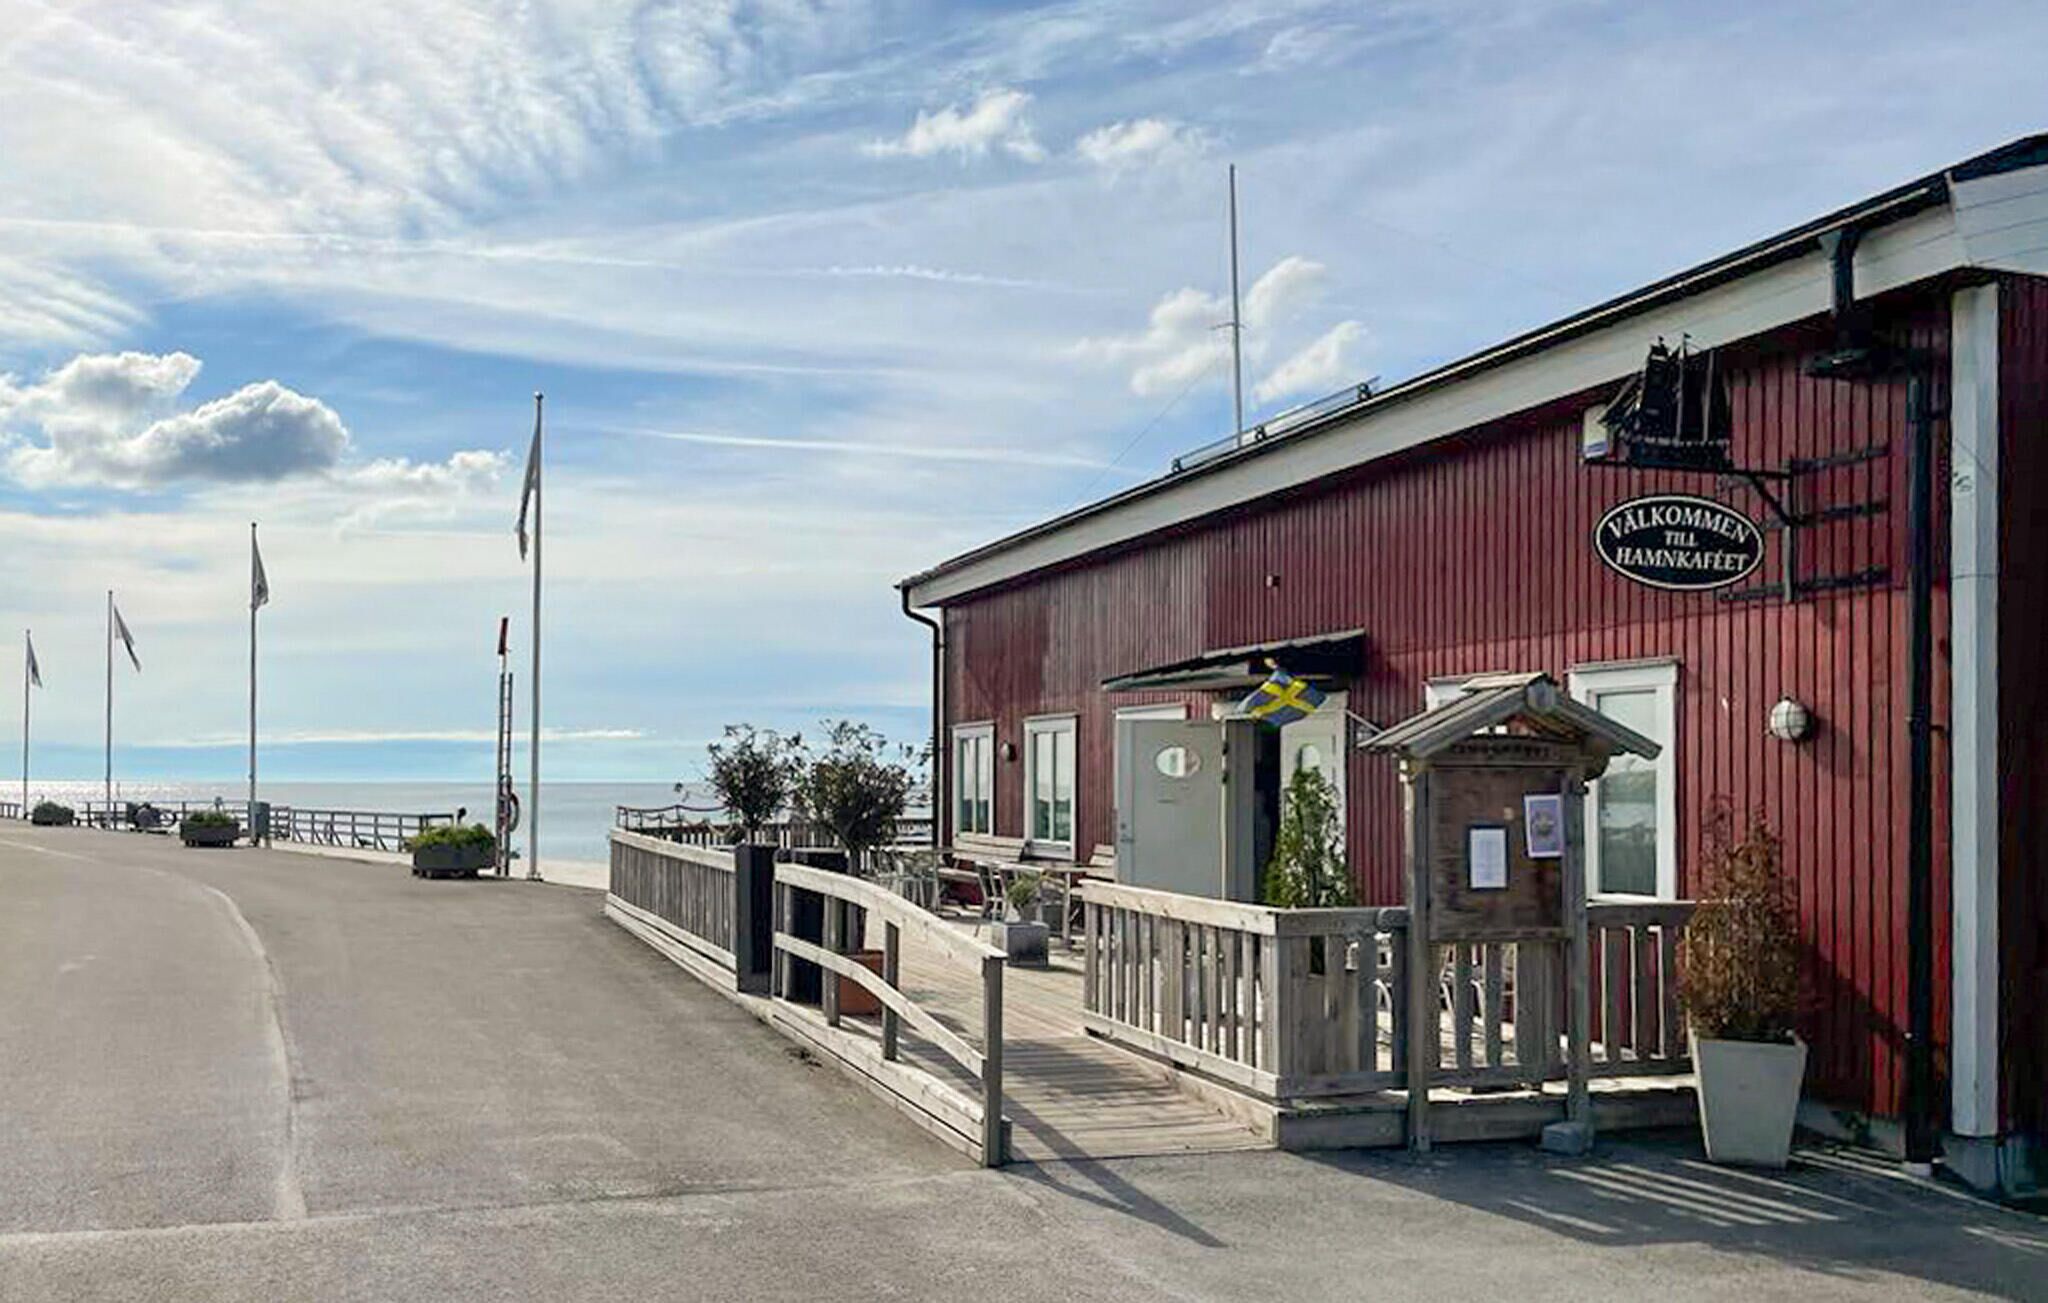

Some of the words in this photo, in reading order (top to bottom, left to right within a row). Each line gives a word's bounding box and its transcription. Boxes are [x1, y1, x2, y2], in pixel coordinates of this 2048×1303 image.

[1608, 505, 1750, 544] VÄLKOMMEN
[1664, 530, 1699, 547] TILL
[1615, 548, 1750, 571] HAMNKAFÉET
